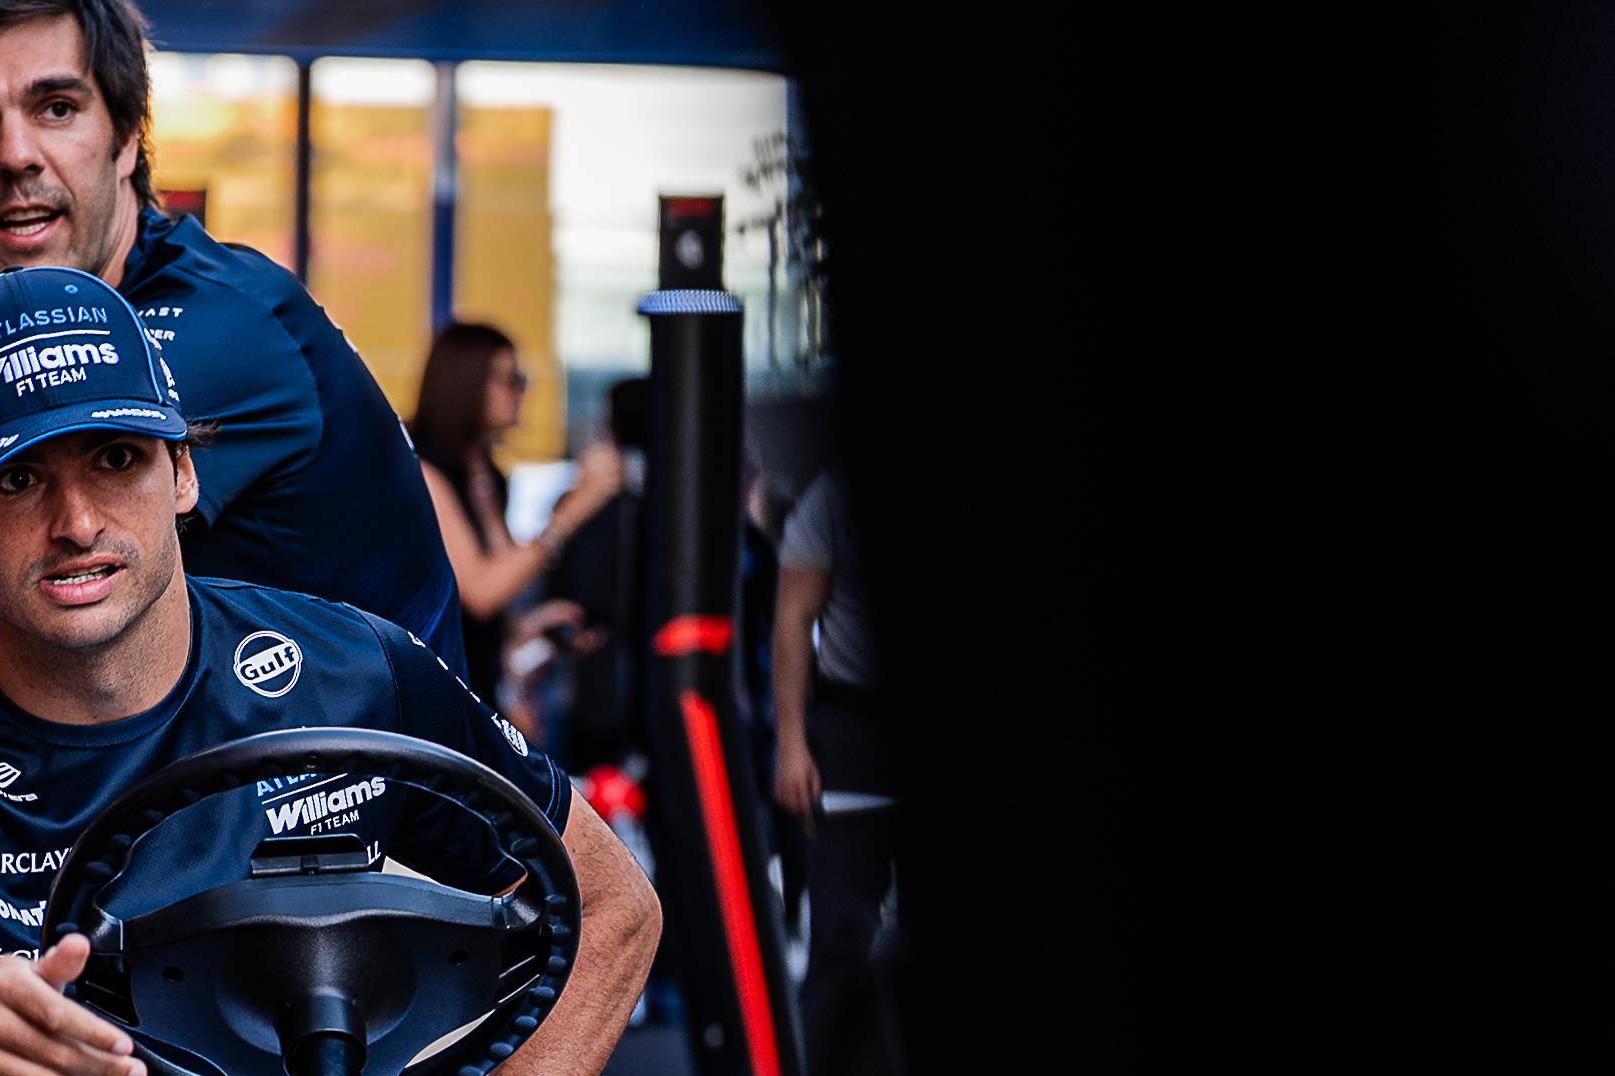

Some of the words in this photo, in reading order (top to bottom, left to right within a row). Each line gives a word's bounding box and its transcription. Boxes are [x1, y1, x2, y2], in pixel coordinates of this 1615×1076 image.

[15, 376, 35, 397] F1
[36, 366, 87, 389] TEAM
[240, 645, 295, 681] Gulf
[265, 776, 386, 835] Williams
[310, 822, 323, 836] F1
[325, 809, 360, 830] TEAM
